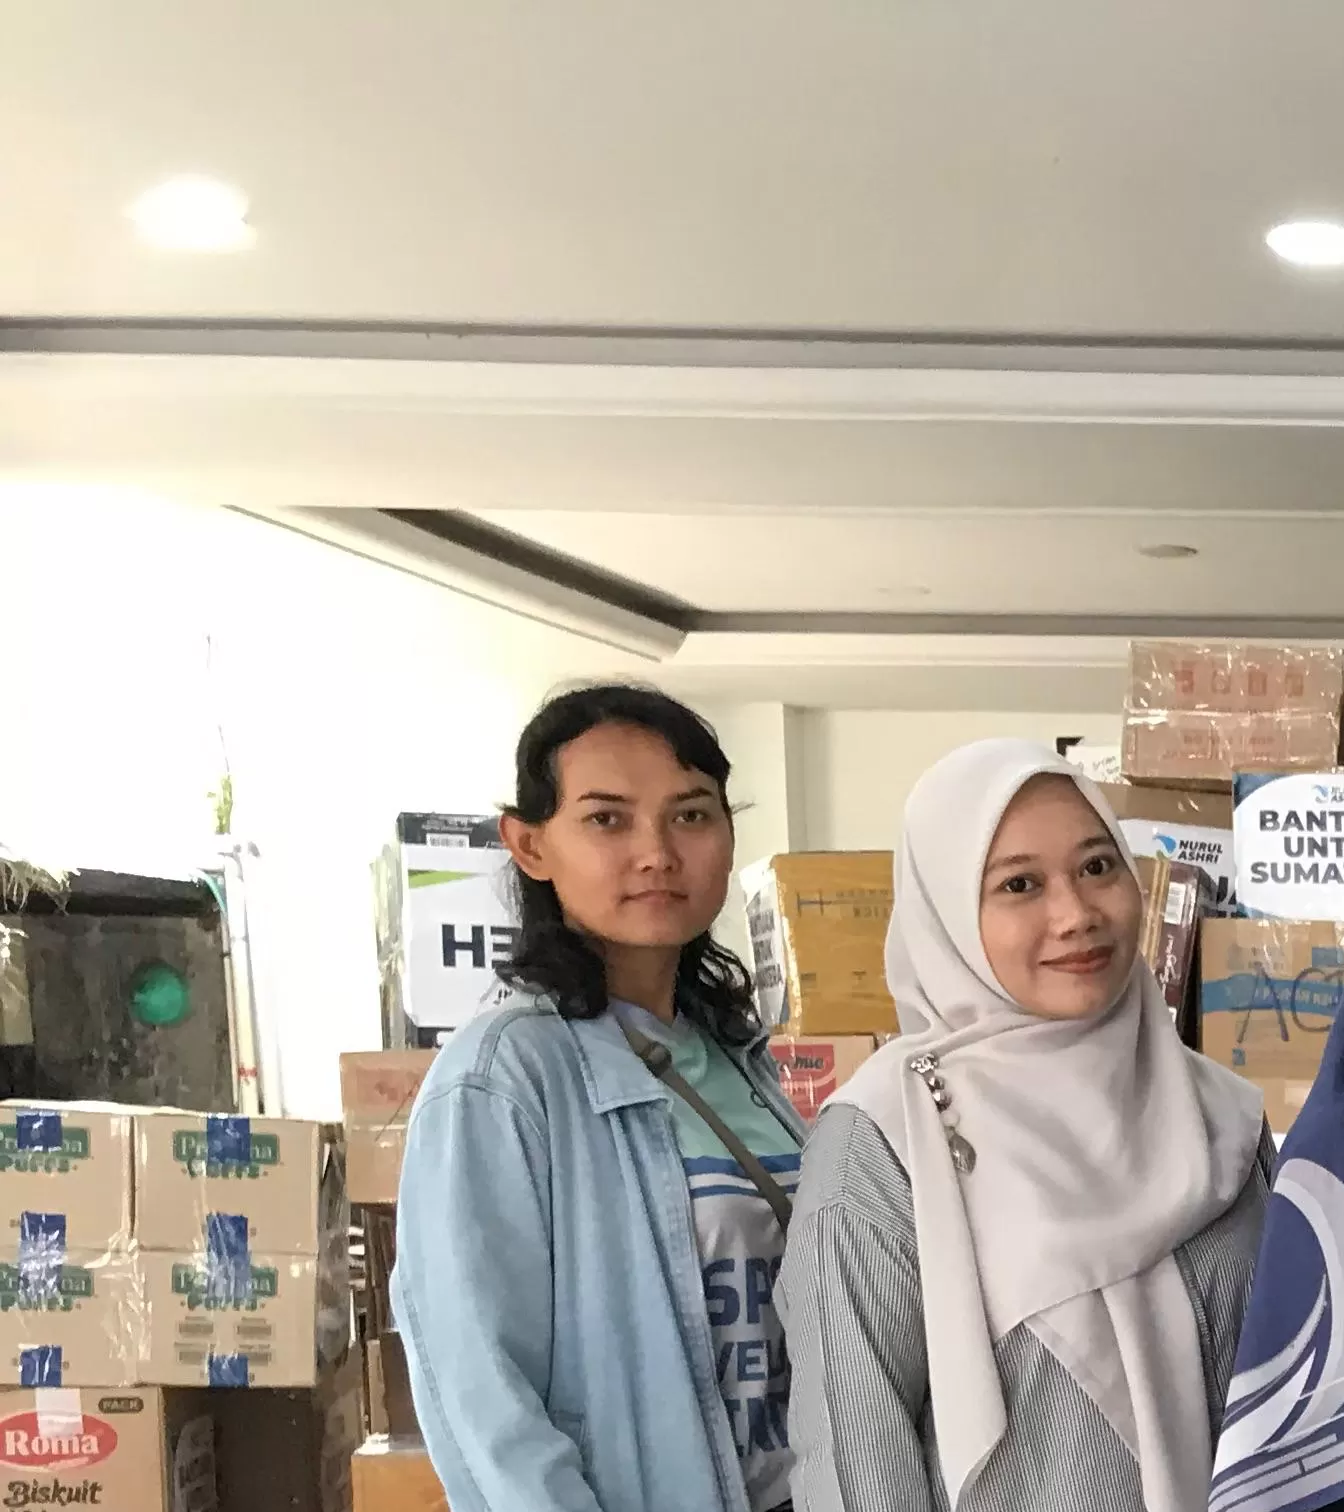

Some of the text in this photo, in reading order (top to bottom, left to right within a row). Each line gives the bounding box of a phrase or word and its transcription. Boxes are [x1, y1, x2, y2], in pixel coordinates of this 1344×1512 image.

[1179, 839, 1223, 853] NURUL
[1178, 851, 1219, 865] ASHRI
[4, 1430, 100, 1456] Roma
[4, 1478, 103, 1507] Biskuit
